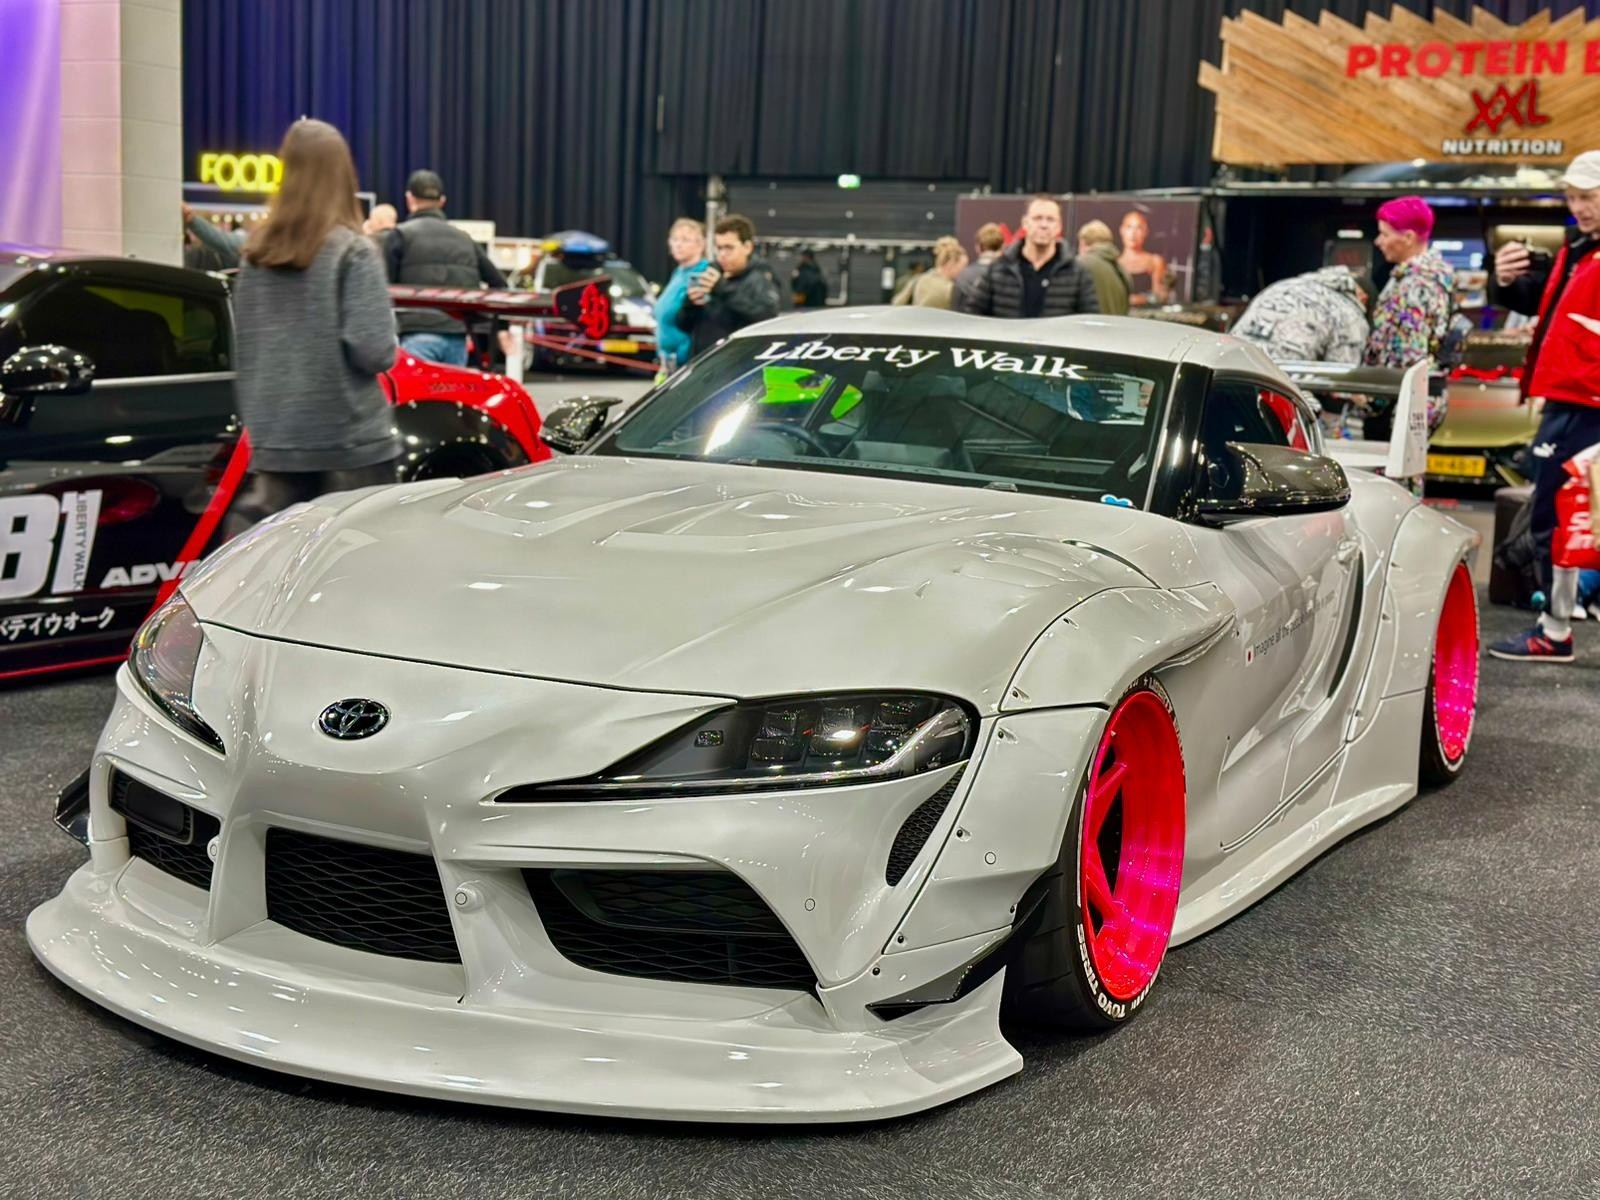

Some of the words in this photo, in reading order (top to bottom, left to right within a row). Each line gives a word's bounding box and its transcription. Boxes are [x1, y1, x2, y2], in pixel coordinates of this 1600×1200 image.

[1346, 39, 1569, 79] PROTEIN
[1463, 79, 1551, 135] XXL
[1442, 138, 1563, 155] NUTRITION
[200, 152, 284, 193] FOOD
[754, 341, 940, 368] Liberty
[950, 347, 1088, 380] Walk
[1077, 924, 1098, 995] TIRES
[1098, 993, 1125, 1018] TOYO
